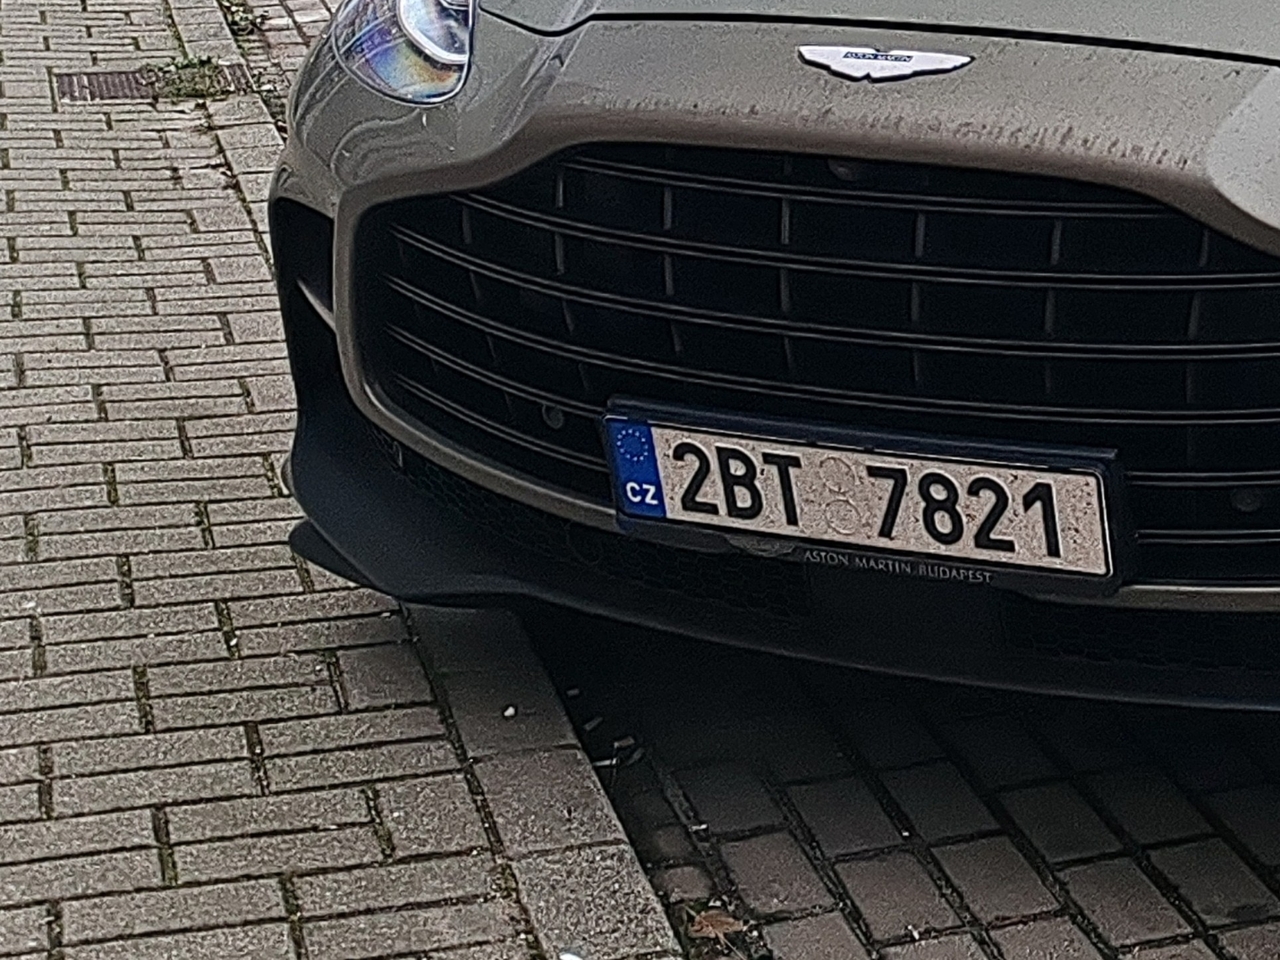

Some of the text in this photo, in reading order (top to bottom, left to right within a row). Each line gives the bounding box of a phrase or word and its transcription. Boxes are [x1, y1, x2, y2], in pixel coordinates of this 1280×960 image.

[625, 481, 659, 505] CZ
[672, 441, 1062, 559] 2BT 7821
[803, 550, 992, 583] ASTON MARTIN BUDAPEST
